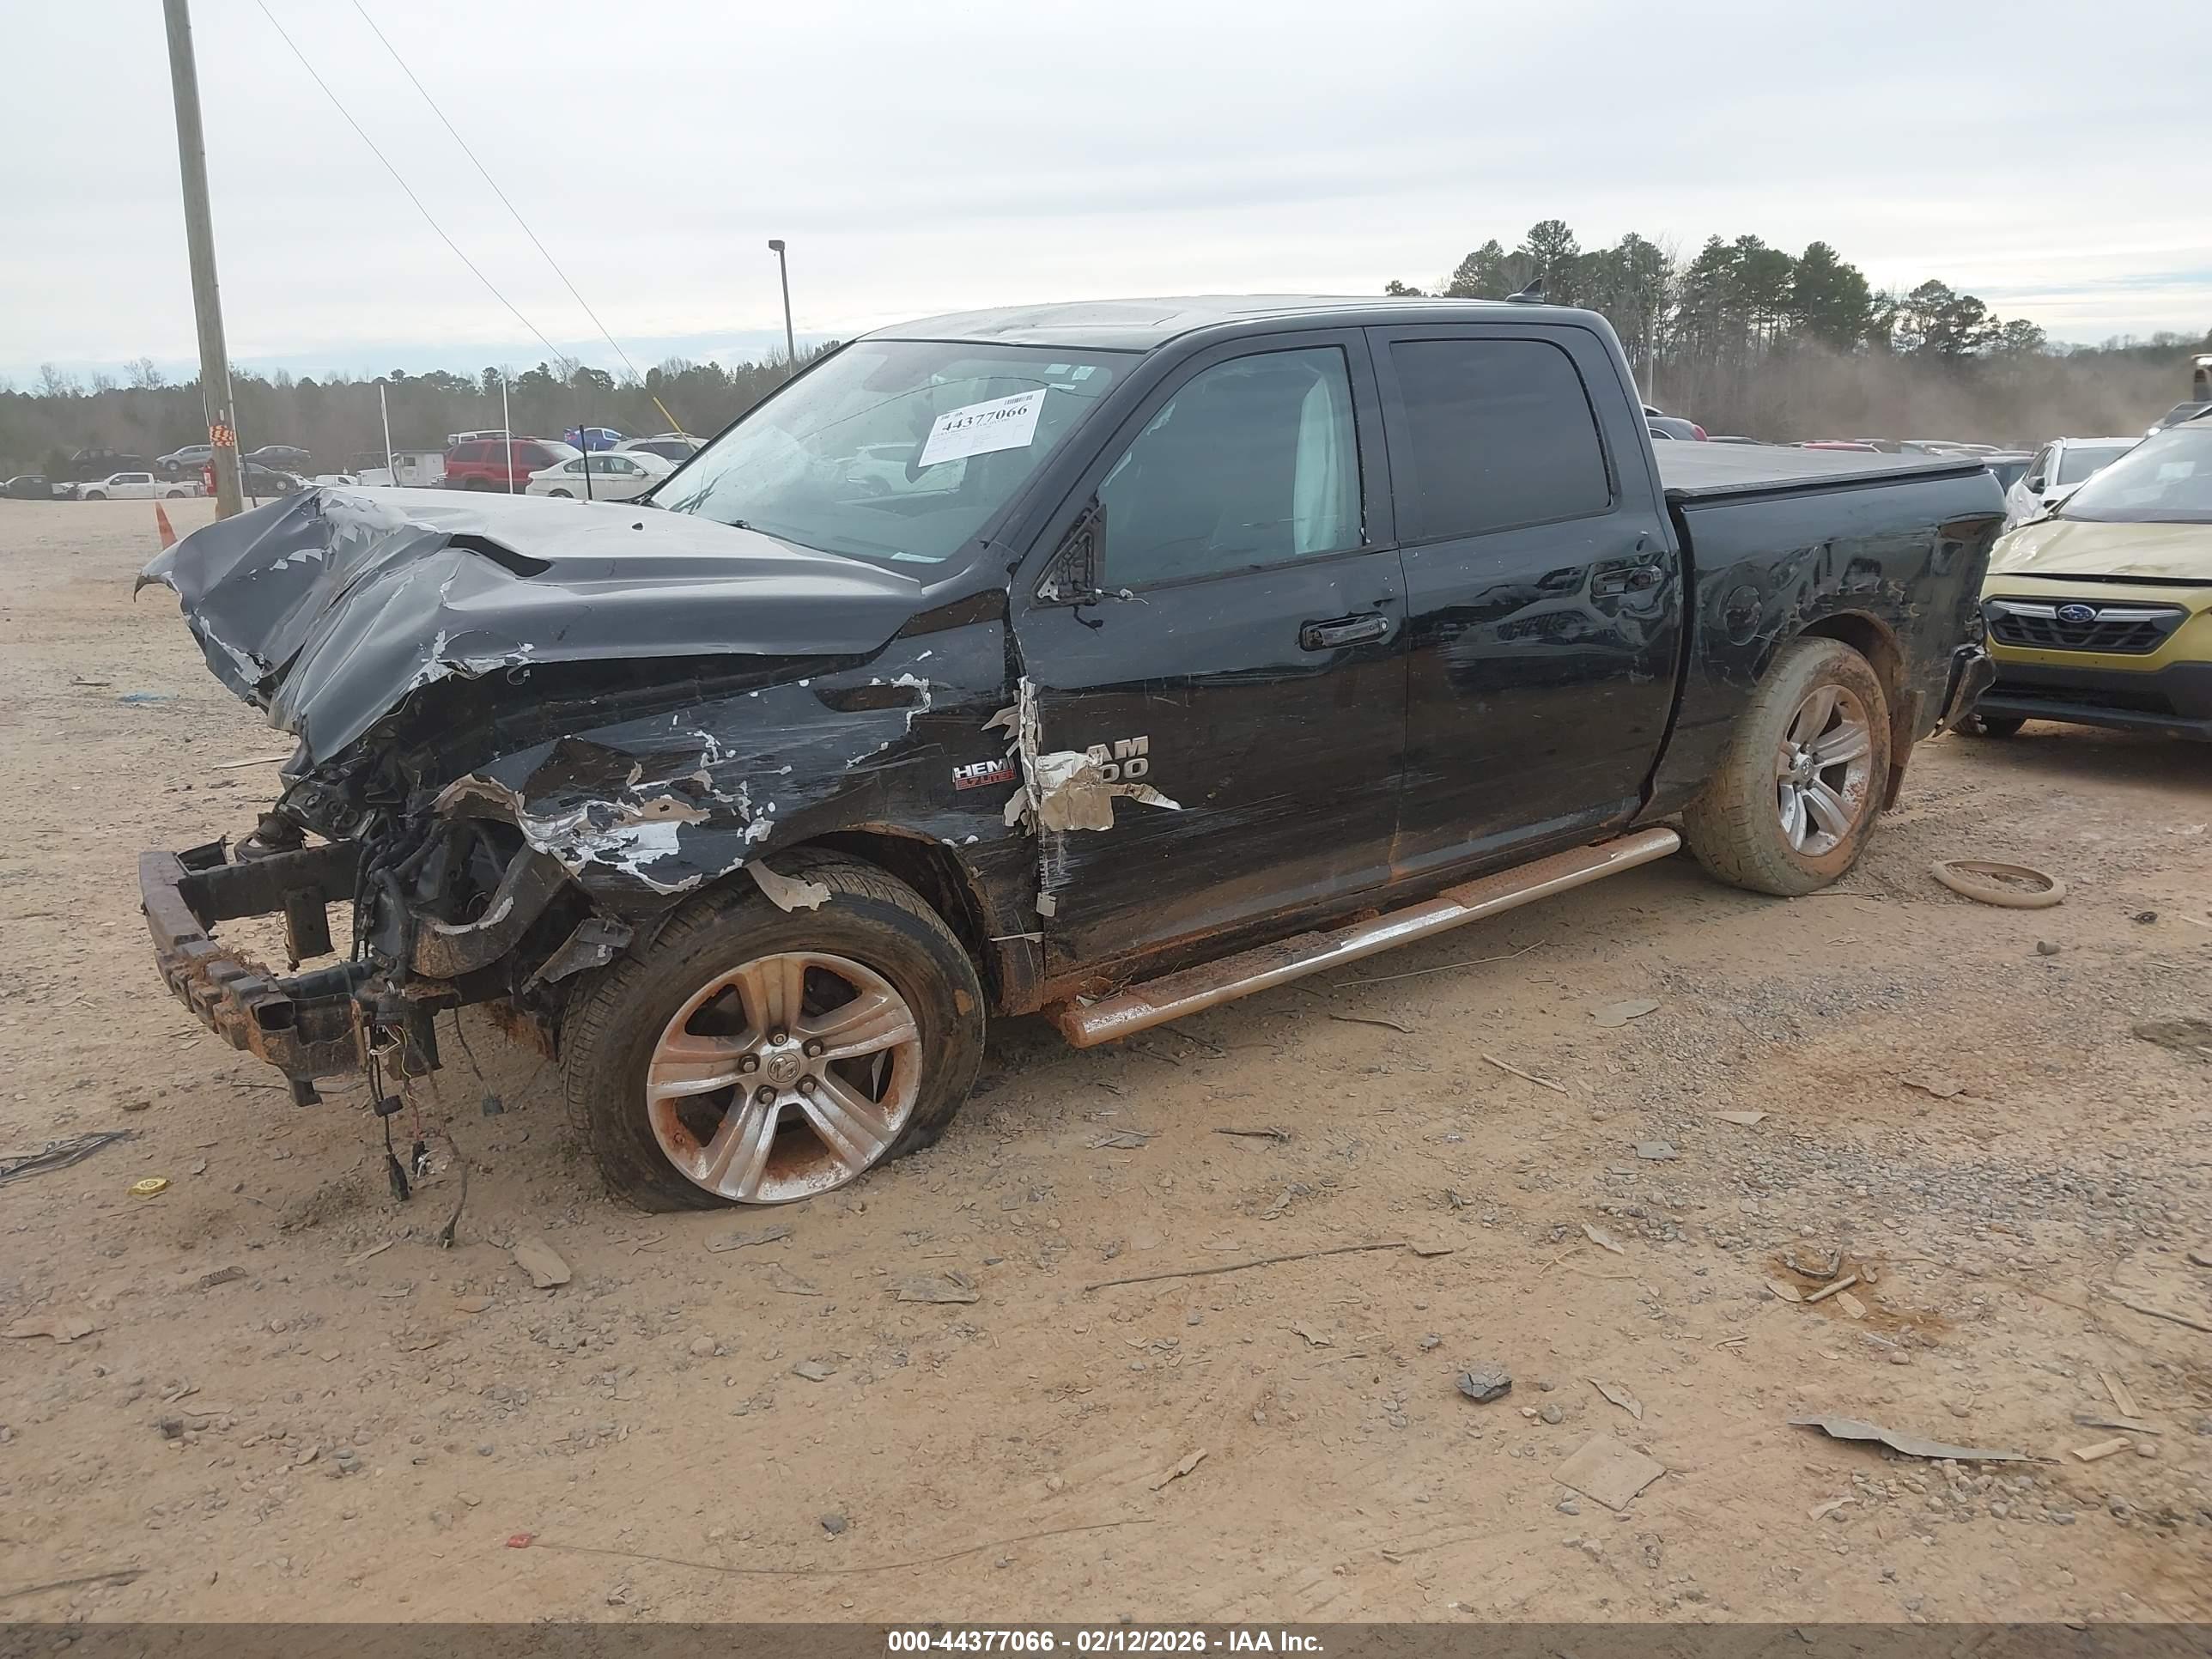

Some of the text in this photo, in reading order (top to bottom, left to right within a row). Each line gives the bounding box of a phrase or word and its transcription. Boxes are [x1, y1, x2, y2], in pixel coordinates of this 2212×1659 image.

[942, 404, 1029, 431] 44377066
[1085, 735, 1149, 763] AM
[1098, 757, 1149, 783] 00
